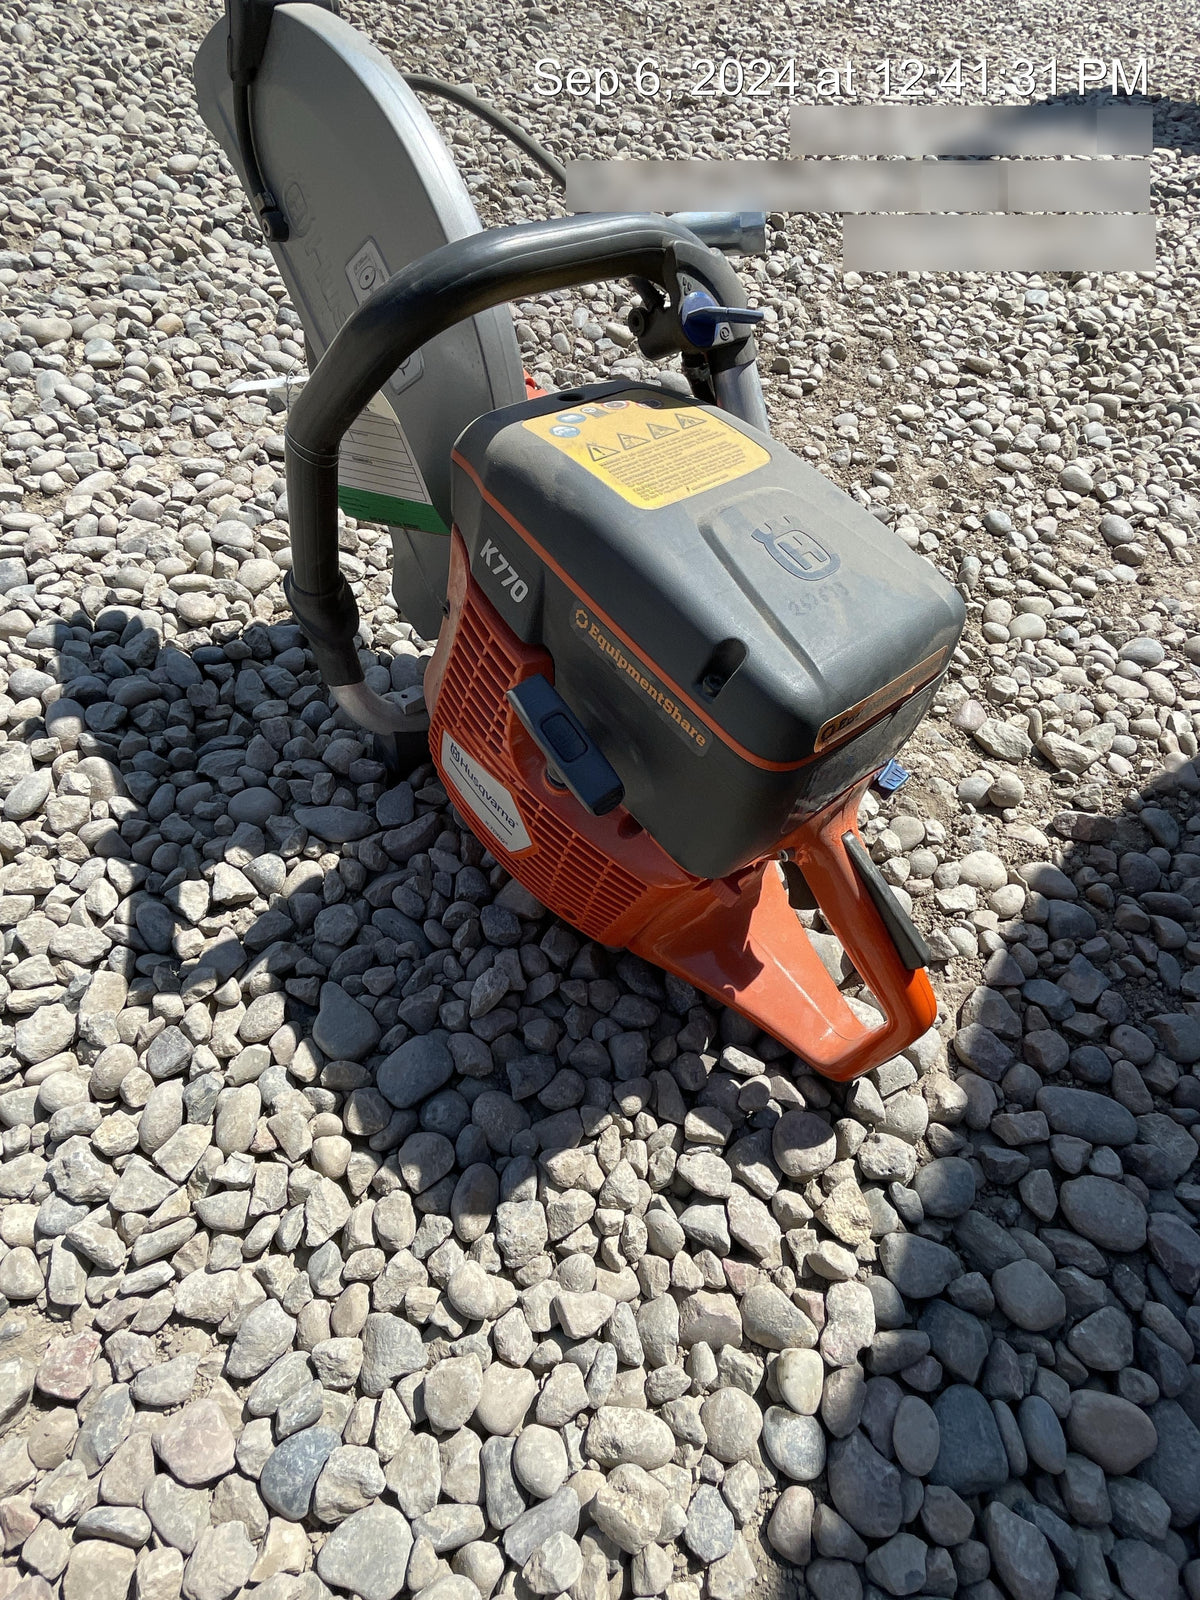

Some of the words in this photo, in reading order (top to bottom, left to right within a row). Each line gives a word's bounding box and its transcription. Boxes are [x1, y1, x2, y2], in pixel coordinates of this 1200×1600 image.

[479, 538, 530, 603] K770
[588, 622, 707, 748] EquipmentShare
[459, 757, 517, 829] Husqvarna
